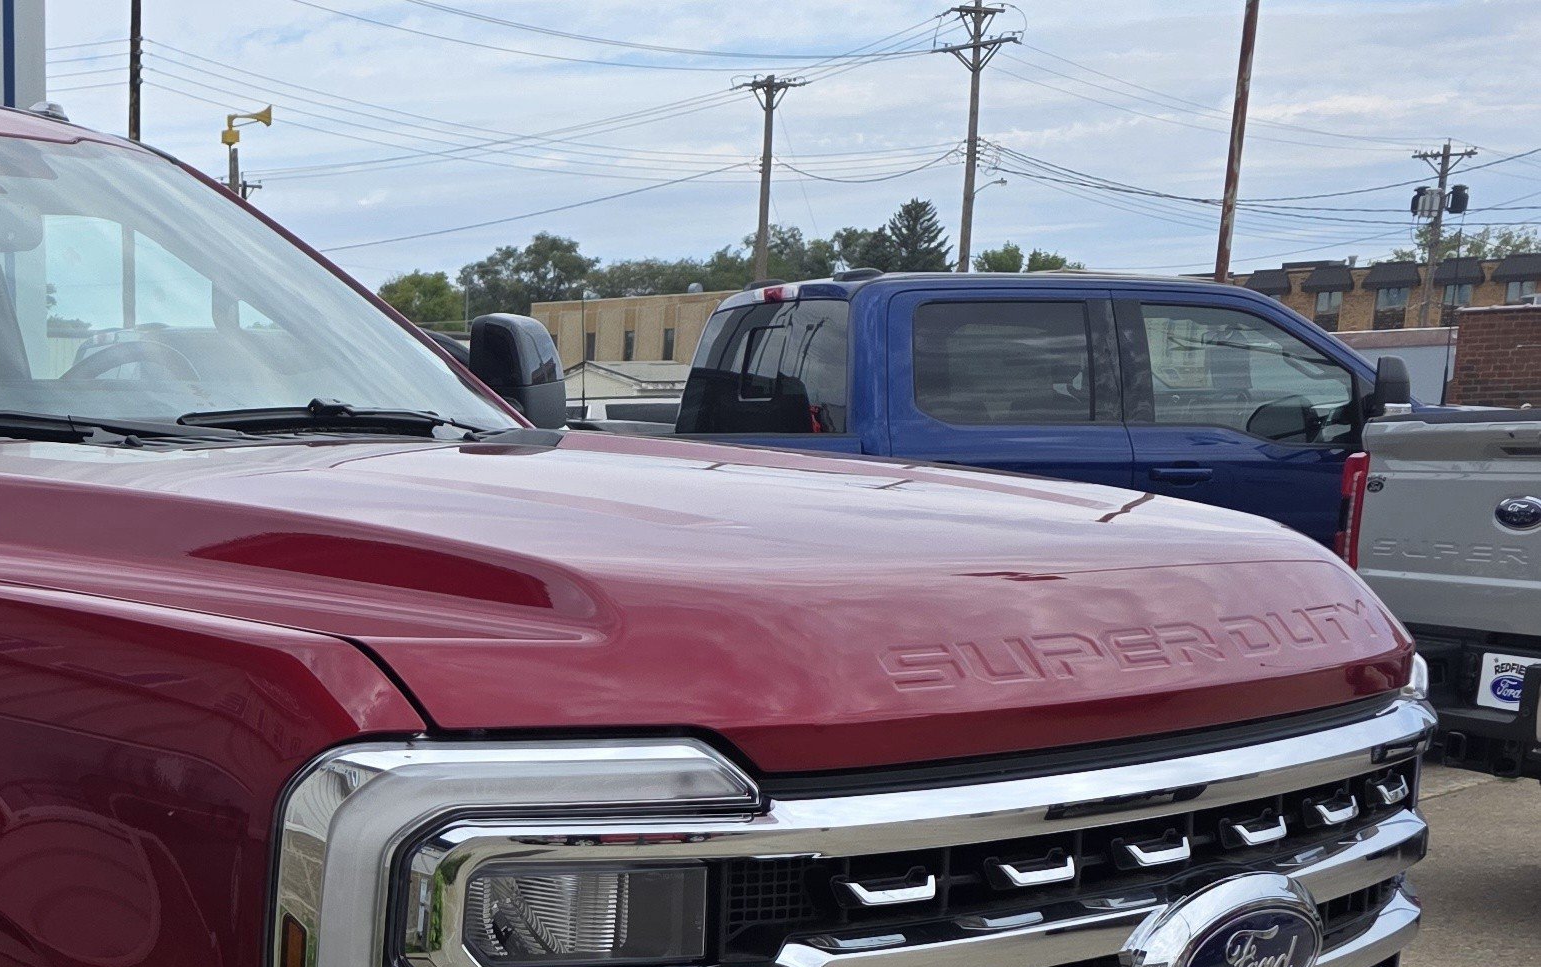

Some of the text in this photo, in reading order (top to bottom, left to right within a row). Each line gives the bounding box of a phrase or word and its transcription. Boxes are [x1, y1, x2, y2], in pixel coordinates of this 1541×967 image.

[876, 599, 1380, 692] SUPER DUTY
[1494, 662, 1527, 675] REDFIE
